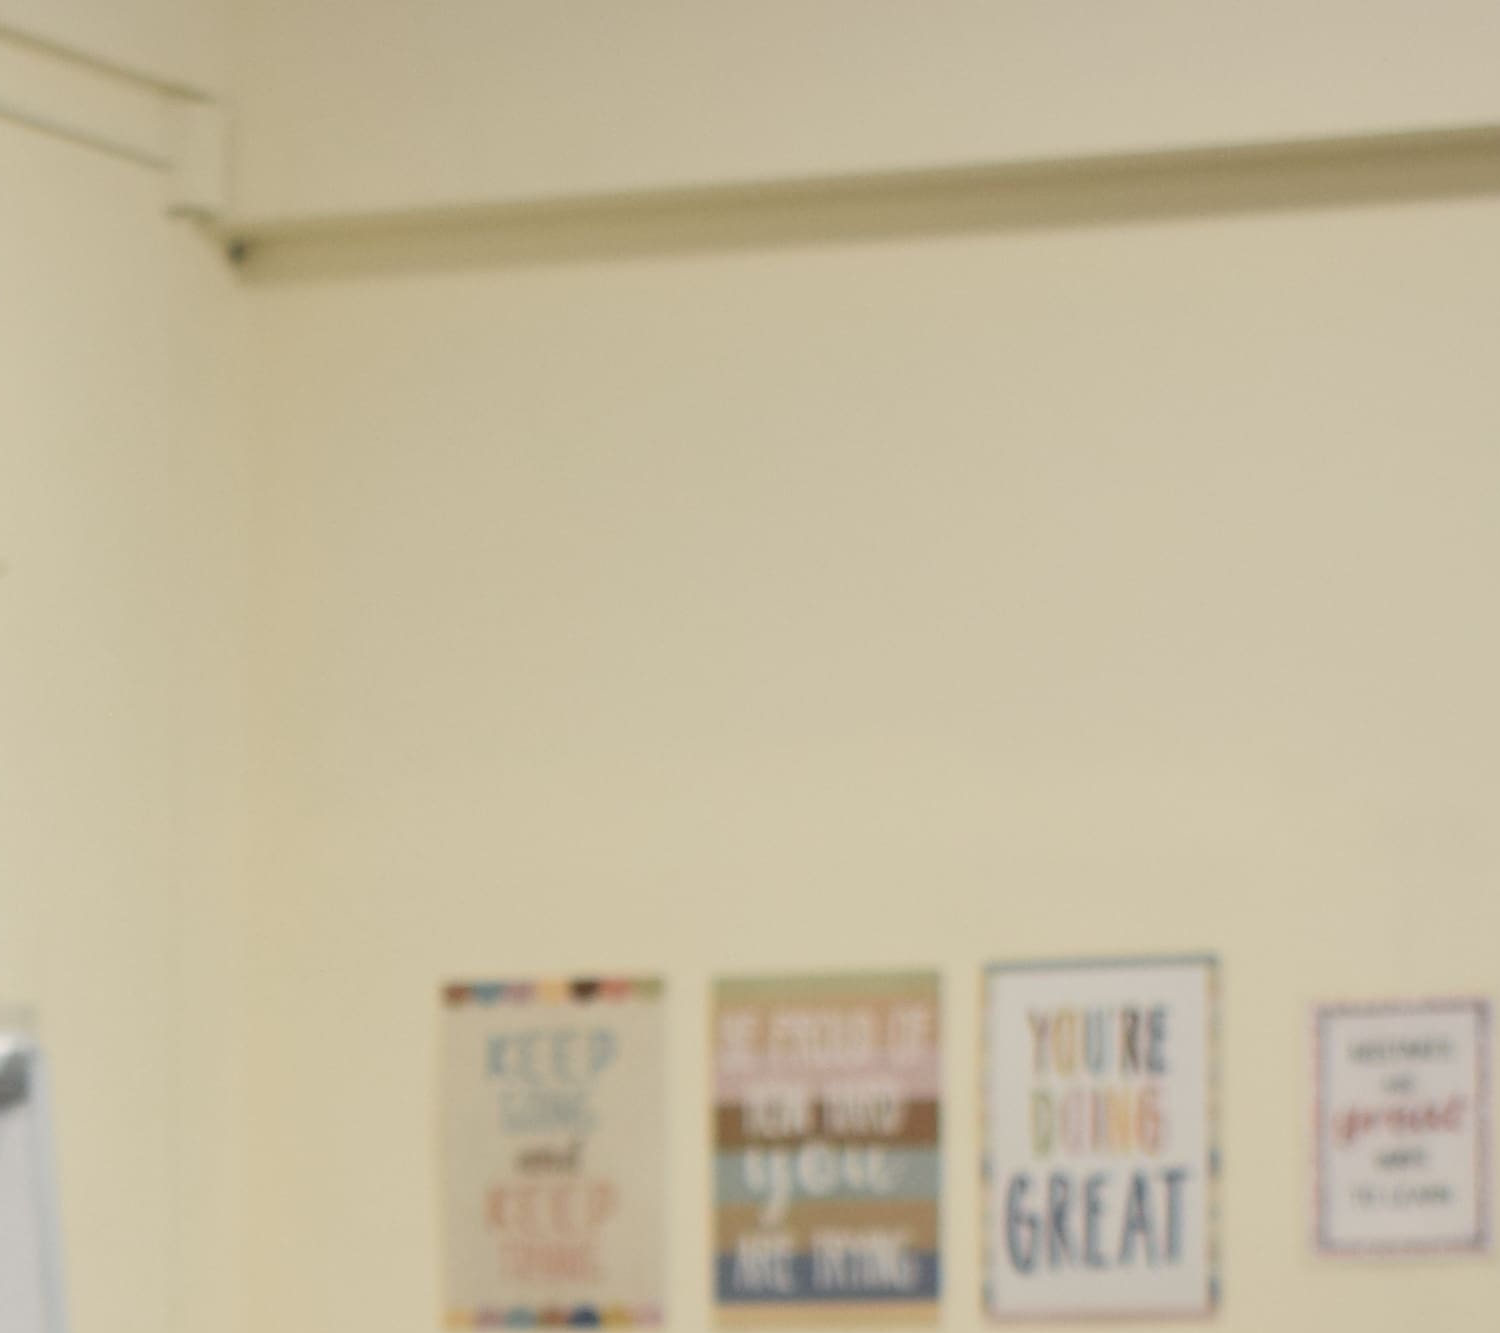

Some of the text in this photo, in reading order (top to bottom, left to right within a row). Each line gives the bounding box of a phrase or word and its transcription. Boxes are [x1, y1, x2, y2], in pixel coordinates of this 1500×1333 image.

[487, 1029, 617, 1080] KEEP
[1029, 1087, 1166, 1158] DOING
[1005, 1167, 1189, 1278] GREAT
